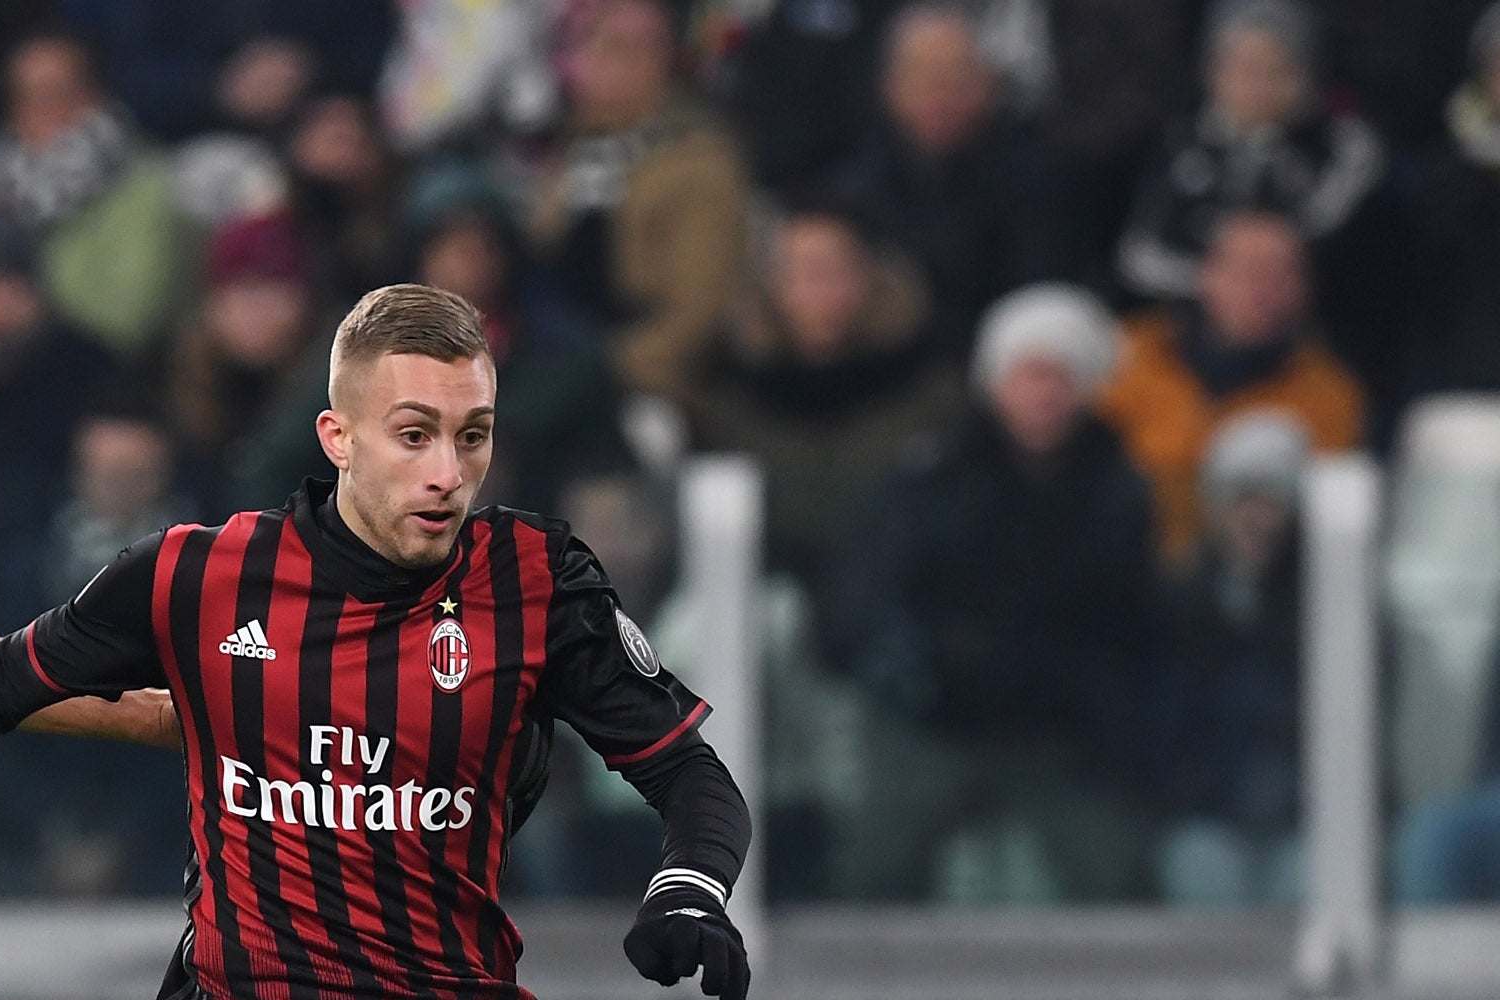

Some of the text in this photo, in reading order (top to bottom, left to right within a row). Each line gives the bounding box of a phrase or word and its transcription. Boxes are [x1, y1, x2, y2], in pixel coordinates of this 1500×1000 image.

[437, 624, 462, 638] ACM
[219, 641, 276, 660] adidas
[439, 675, 460, 684] 1899
[309, 725, 390, 774] Fly
[220, 755, 476, 832] Emirates
